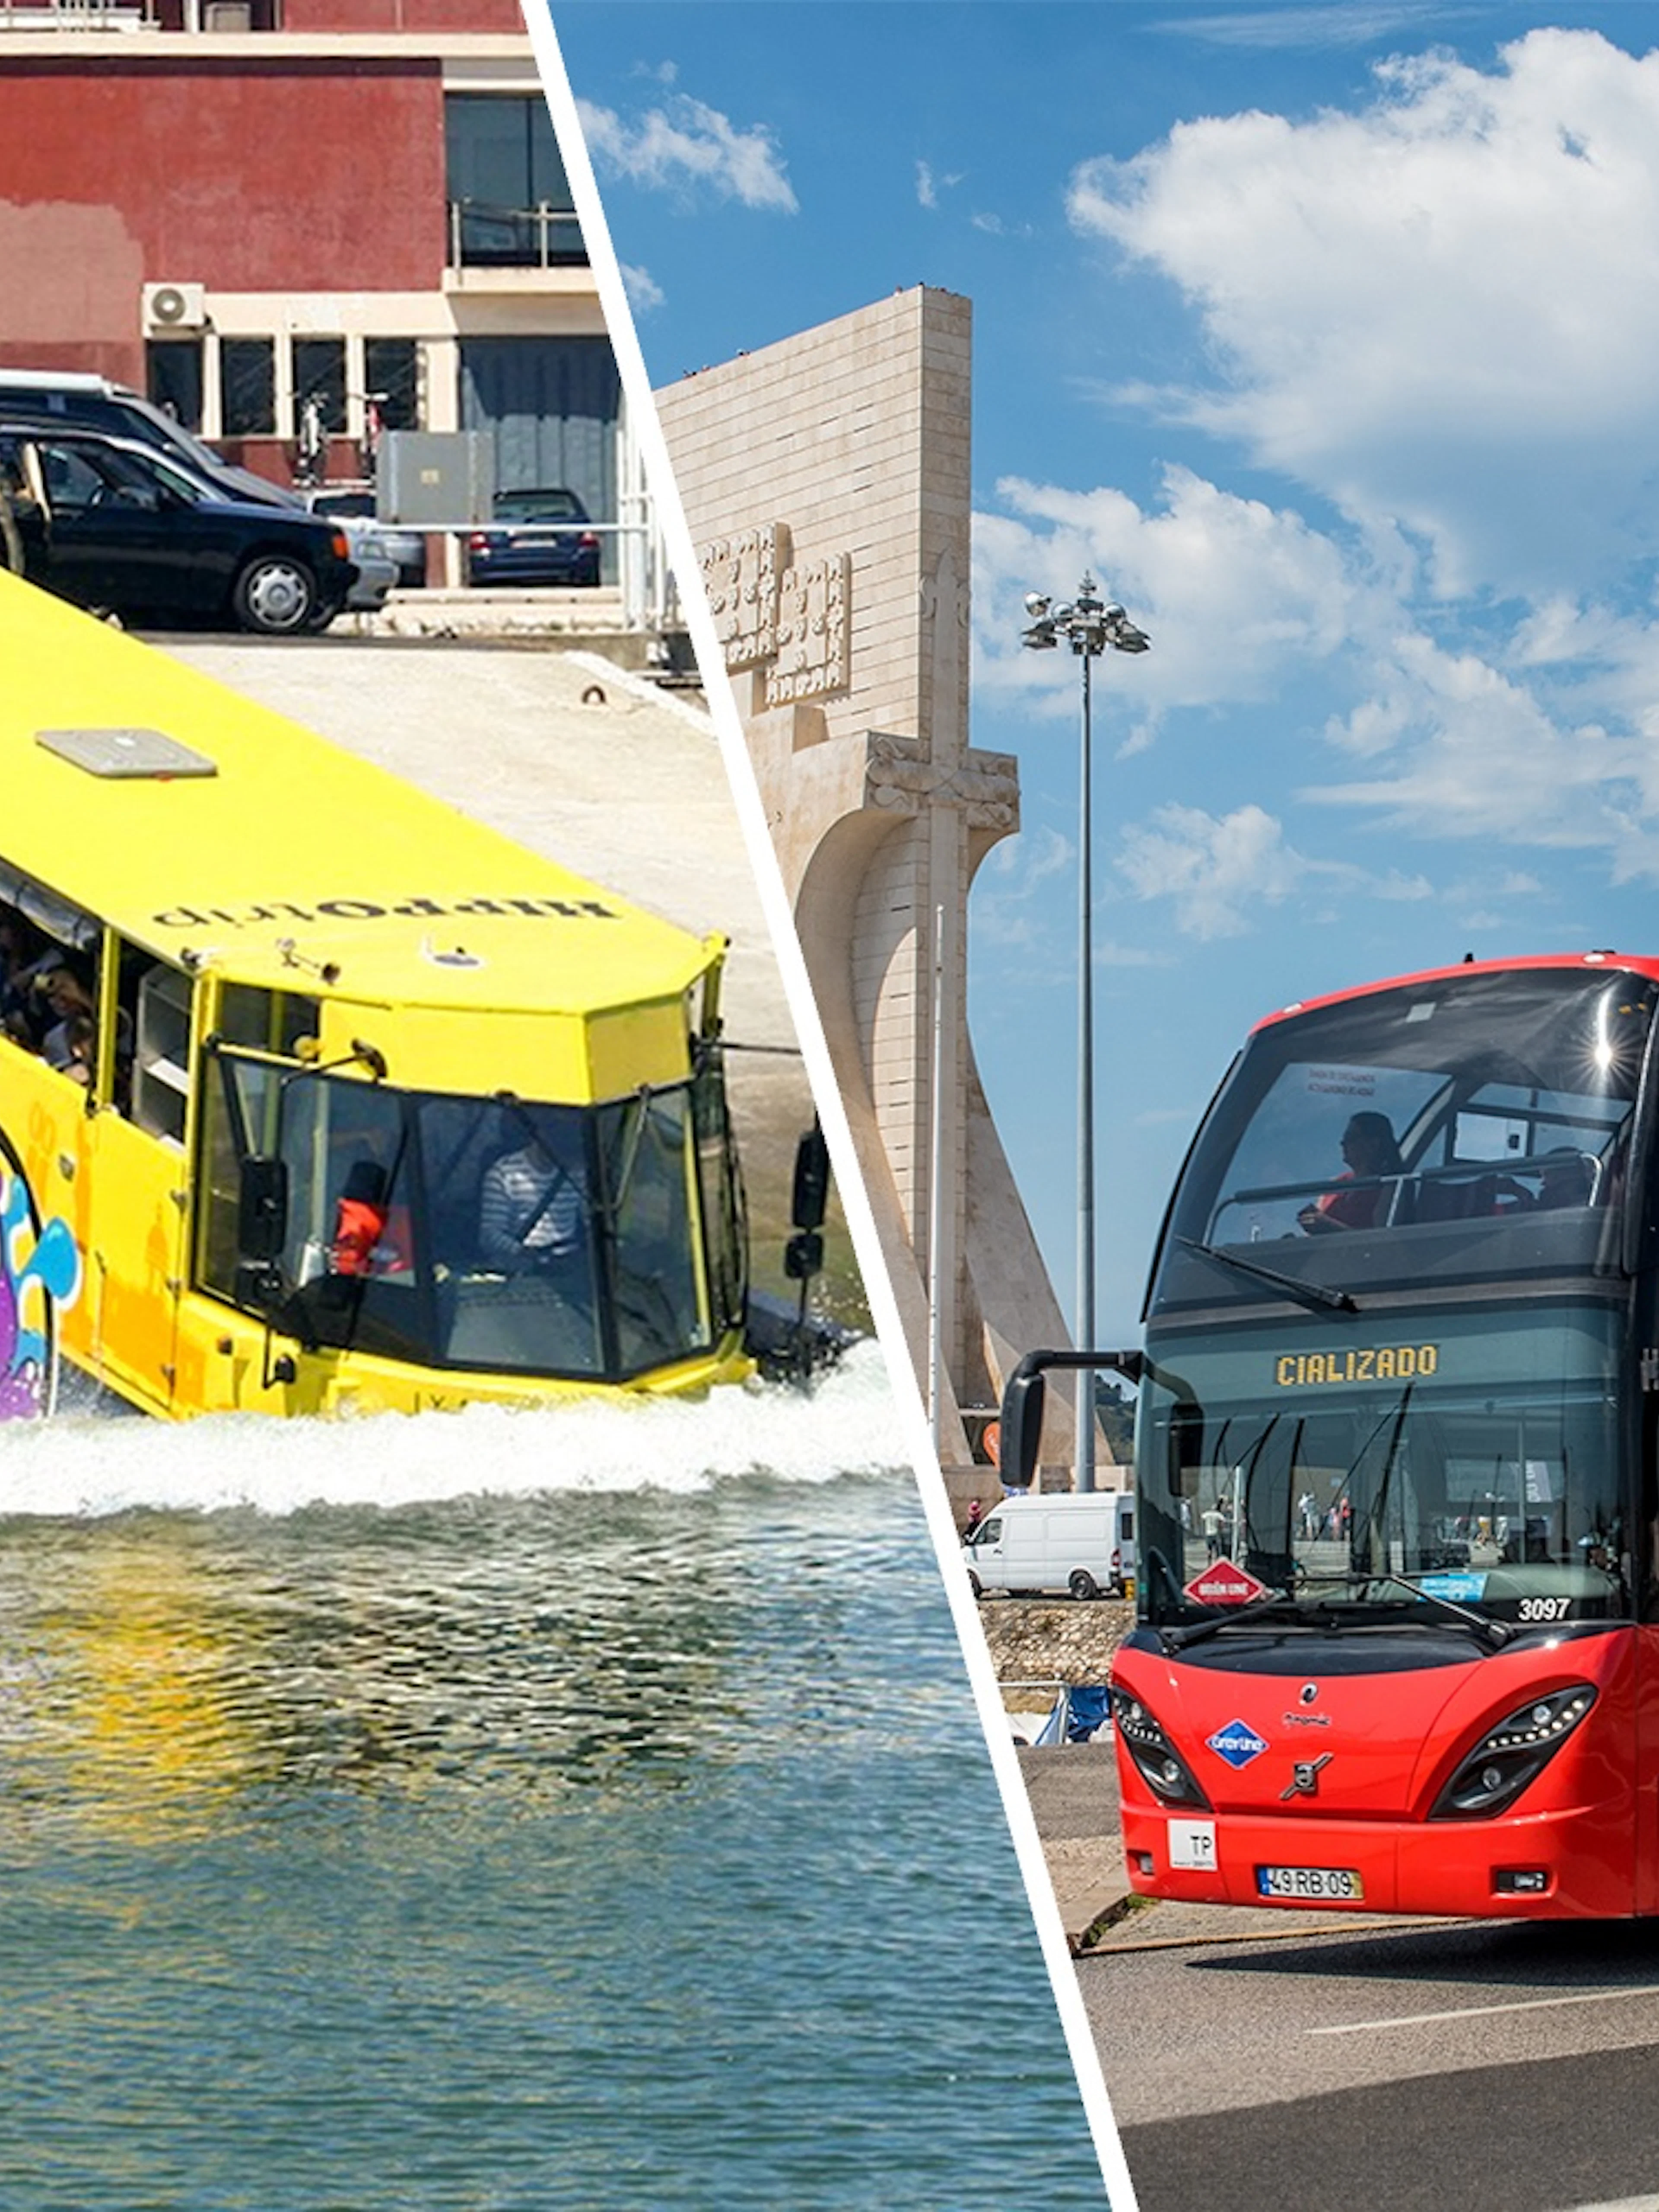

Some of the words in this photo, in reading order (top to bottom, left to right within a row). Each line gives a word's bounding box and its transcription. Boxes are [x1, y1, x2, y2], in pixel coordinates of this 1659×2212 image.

[1277, 1345, 1437, 1386] CIALIZADO
[1518, 1598, 1572, 1621] 3097
[1190, 1835, 1212, 1856] TP
